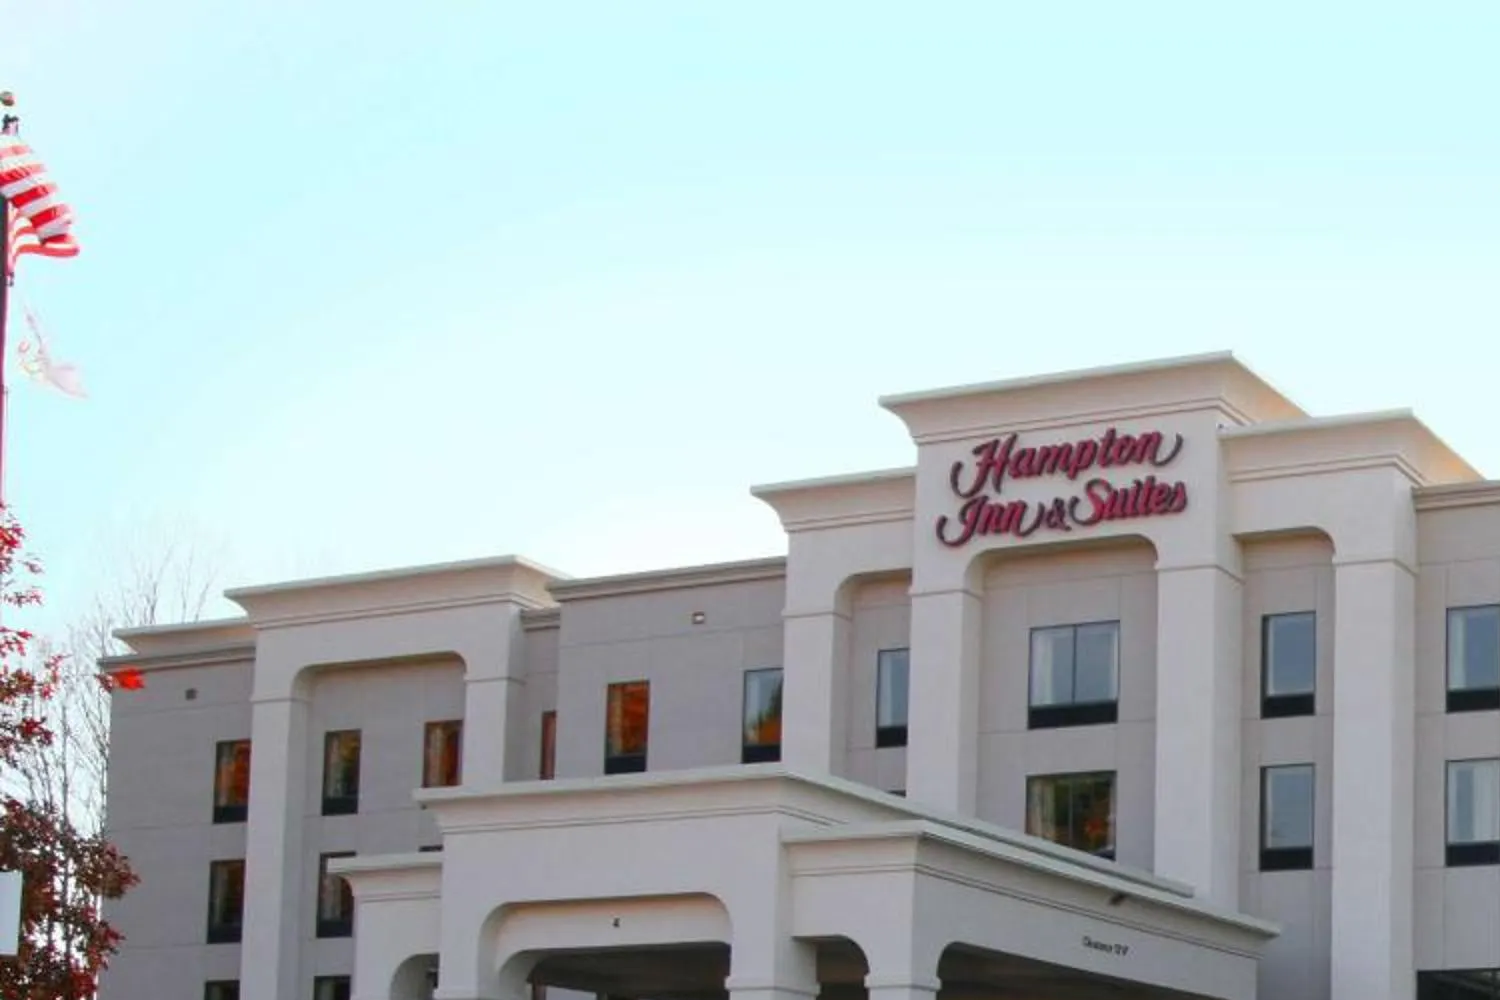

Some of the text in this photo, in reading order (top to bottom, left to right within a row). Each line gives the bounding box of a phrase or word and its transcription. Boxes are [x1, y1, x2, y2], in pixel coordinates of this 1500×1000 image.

[950, 429, 1183, 498] Hampton
[936, 475, 1189, 547] Inn & Suites
